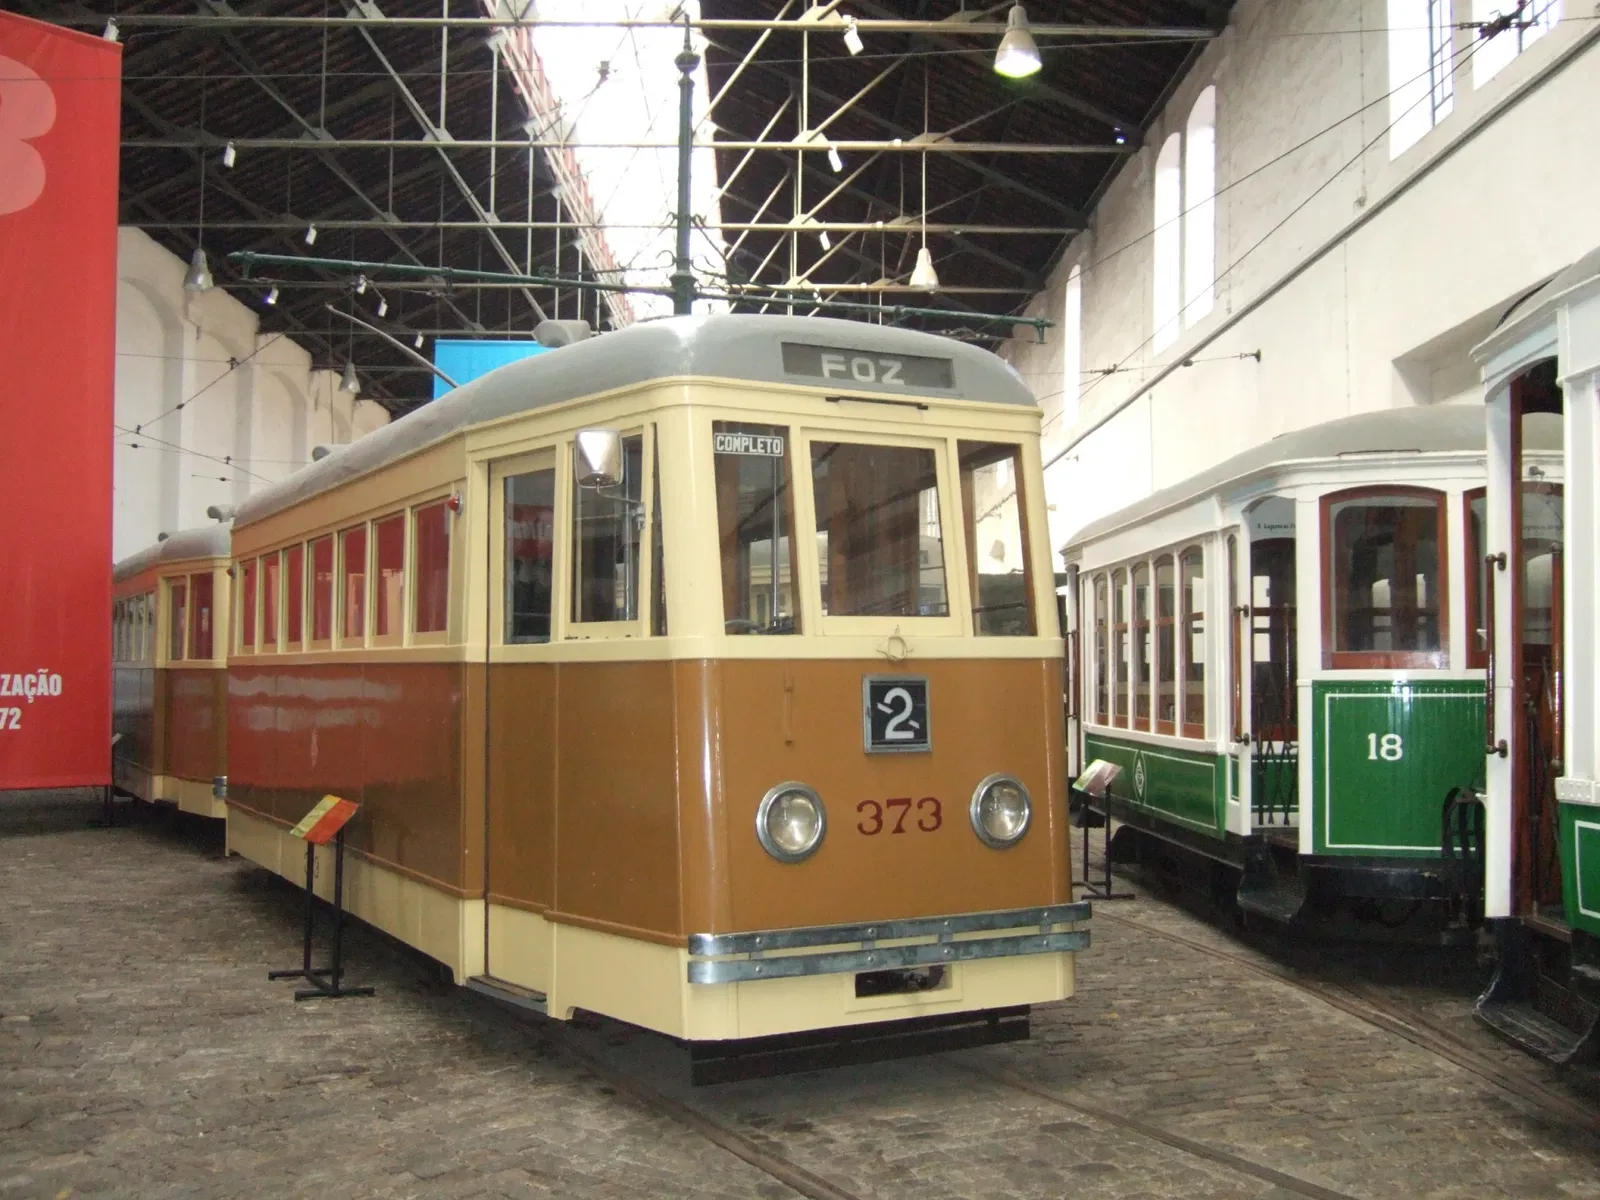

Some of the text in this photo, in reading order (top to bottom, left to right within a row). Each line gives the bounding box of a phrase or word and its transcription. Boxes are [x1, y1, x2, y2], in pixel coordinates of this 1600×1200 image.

[820, 353, 905, 386] FOZ
[716, 434, 781, 454] COMPLETO
[0, 668, 62, 703] ZAÇÃO
[0, 707, 21, 730] 72
[882, 687, 916, 739] 2
[1367, 732, 1403, 761] 18
[856, 796, 943, 836] 373
